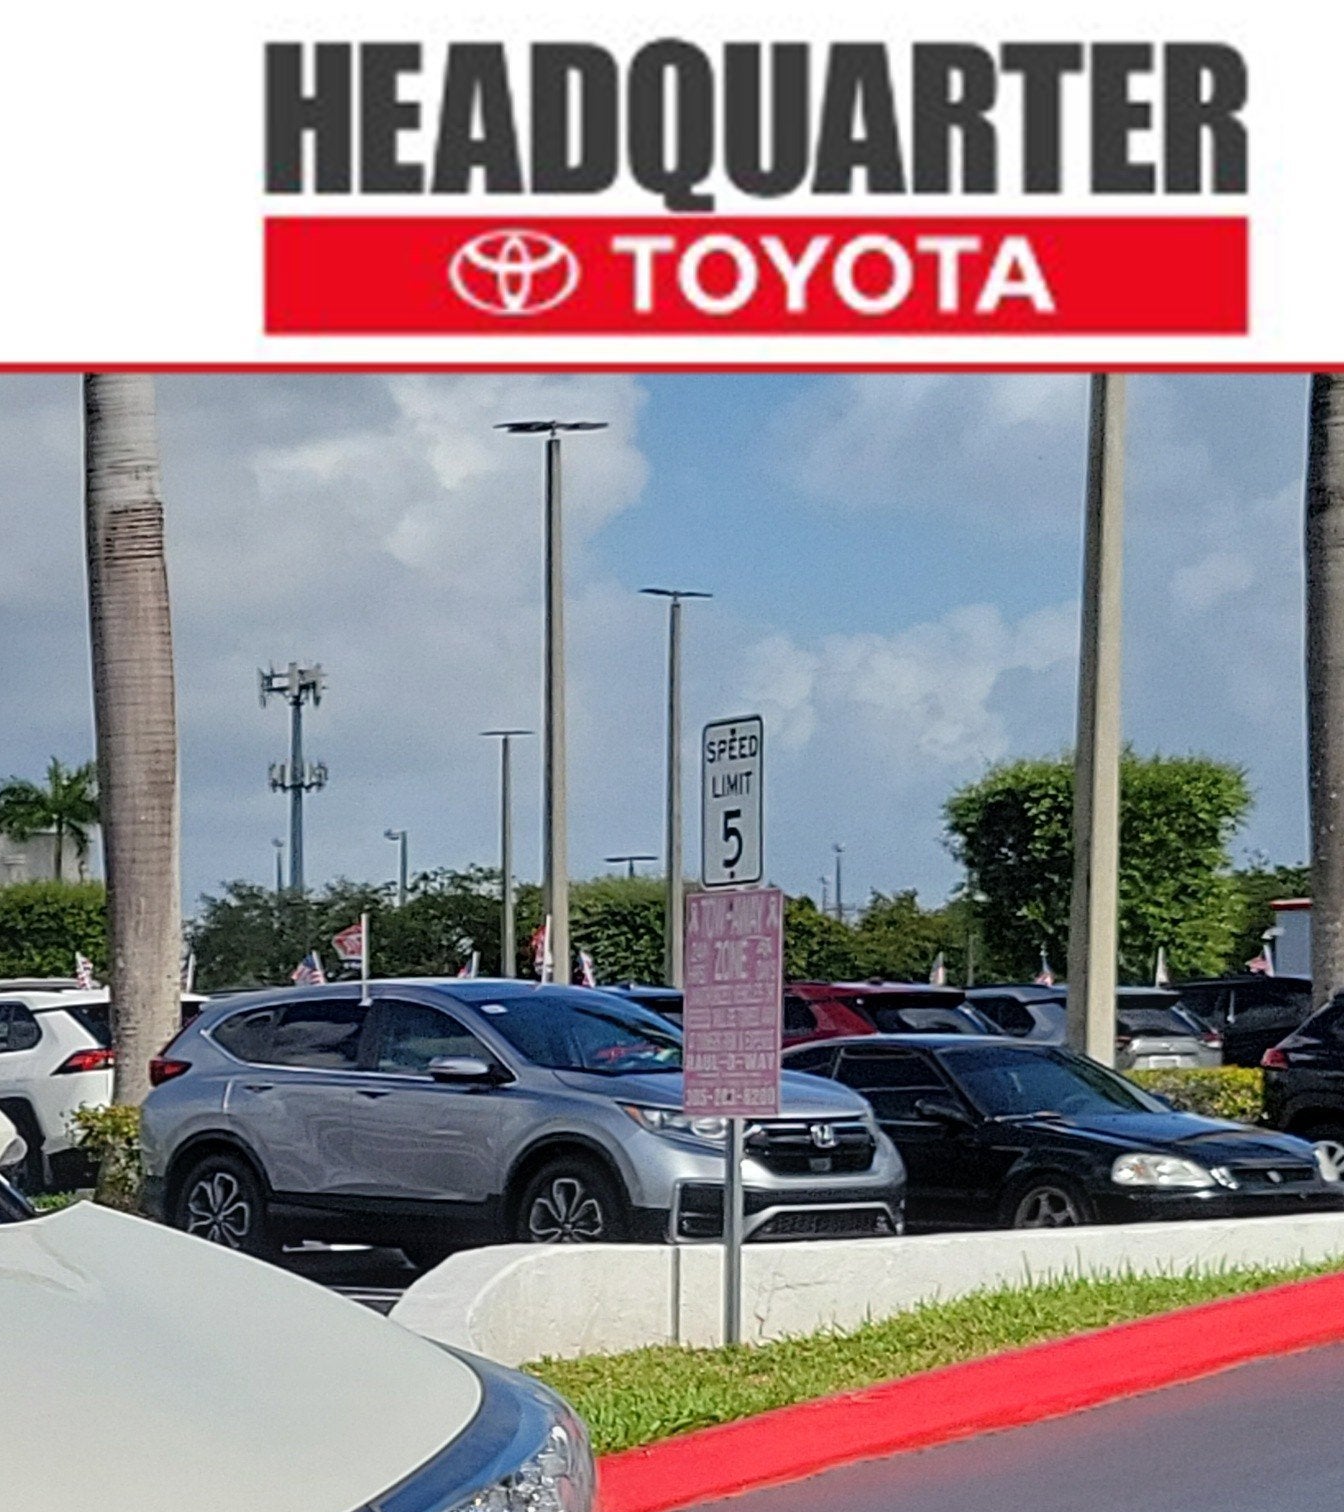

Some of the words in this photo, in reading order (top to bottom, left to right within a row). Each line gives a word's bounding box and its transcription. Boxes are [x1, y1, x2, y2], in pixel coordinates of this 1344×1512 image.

[706, 735, 758, 763] SPEED
[712, 771, 753, 798] LIMIT
[722, 809, 743, 869] 5
[714, 939, 748, 981] ZONE
